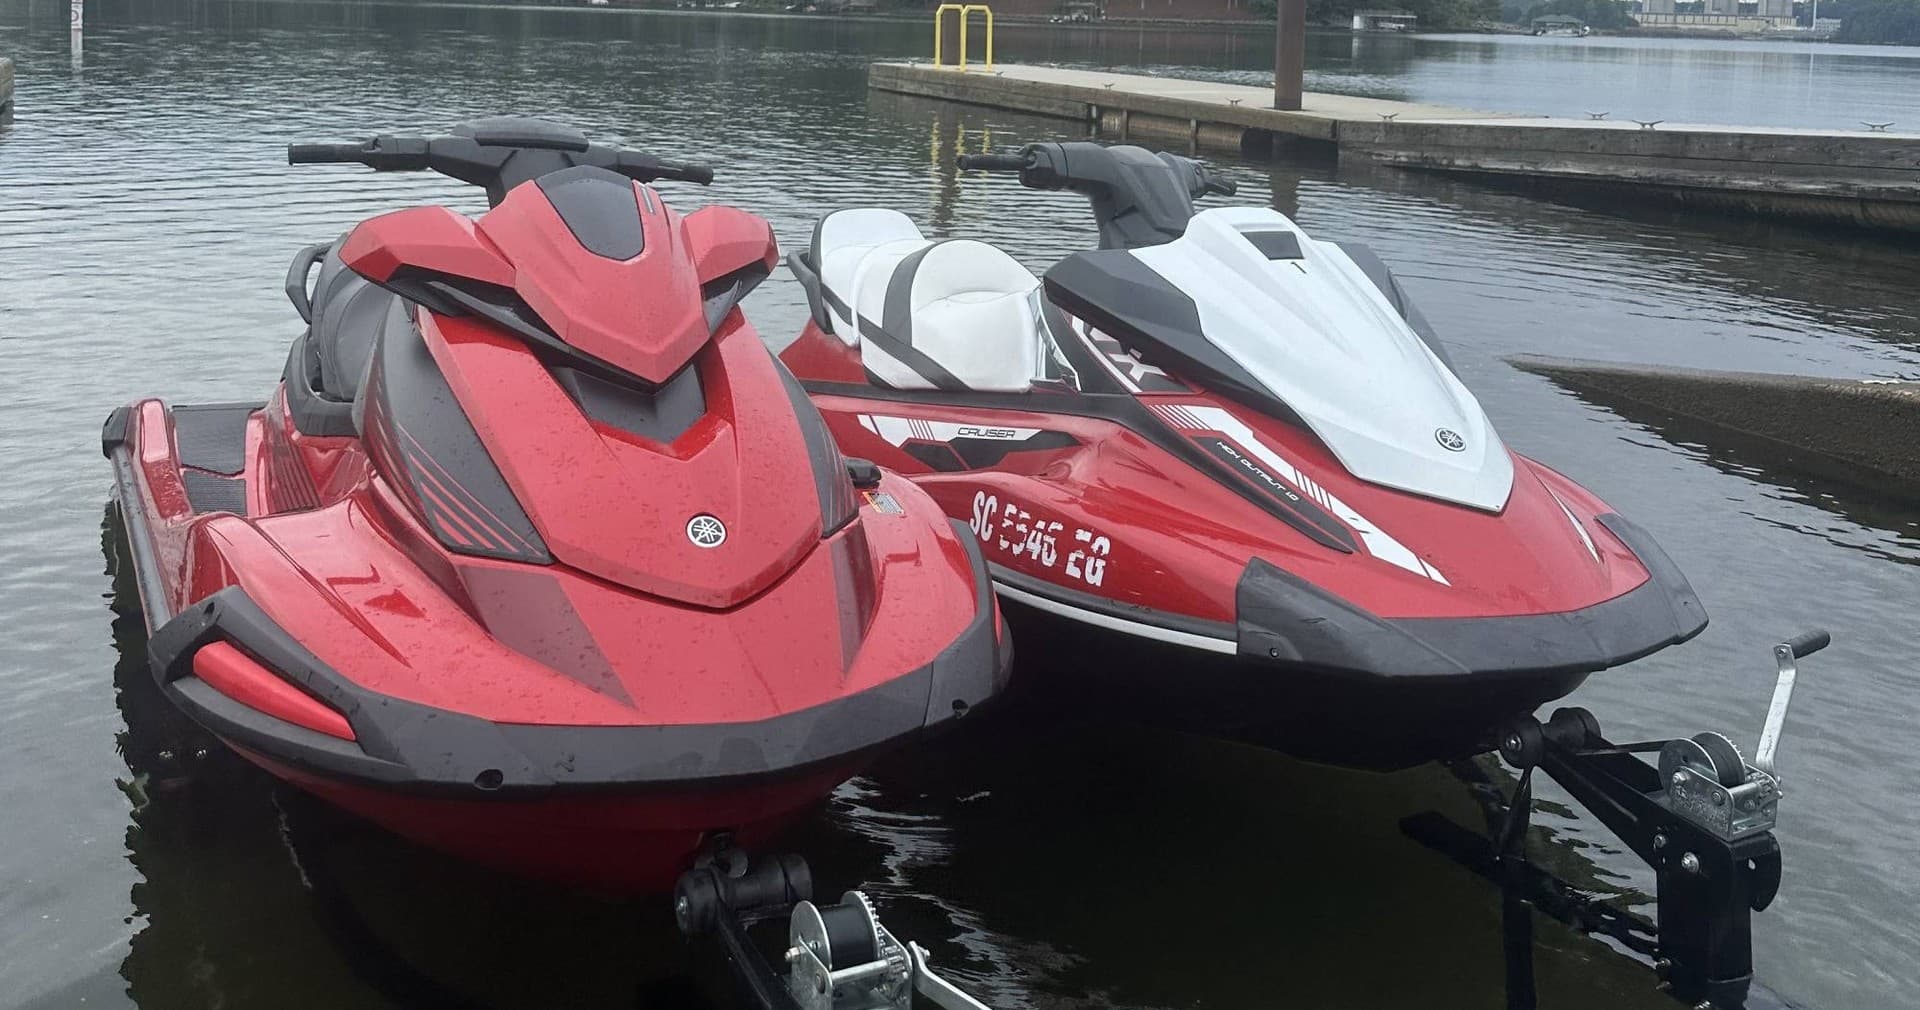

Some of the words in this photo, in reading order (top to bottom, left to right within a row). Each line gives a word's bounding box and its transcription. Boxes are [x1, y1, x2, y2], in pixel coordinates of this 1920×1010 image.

[957, 427, 1016, 438] CRUISER
[1240, 458, 1286, 491] OUTPUT
[970, 491, 997, 541] SC
